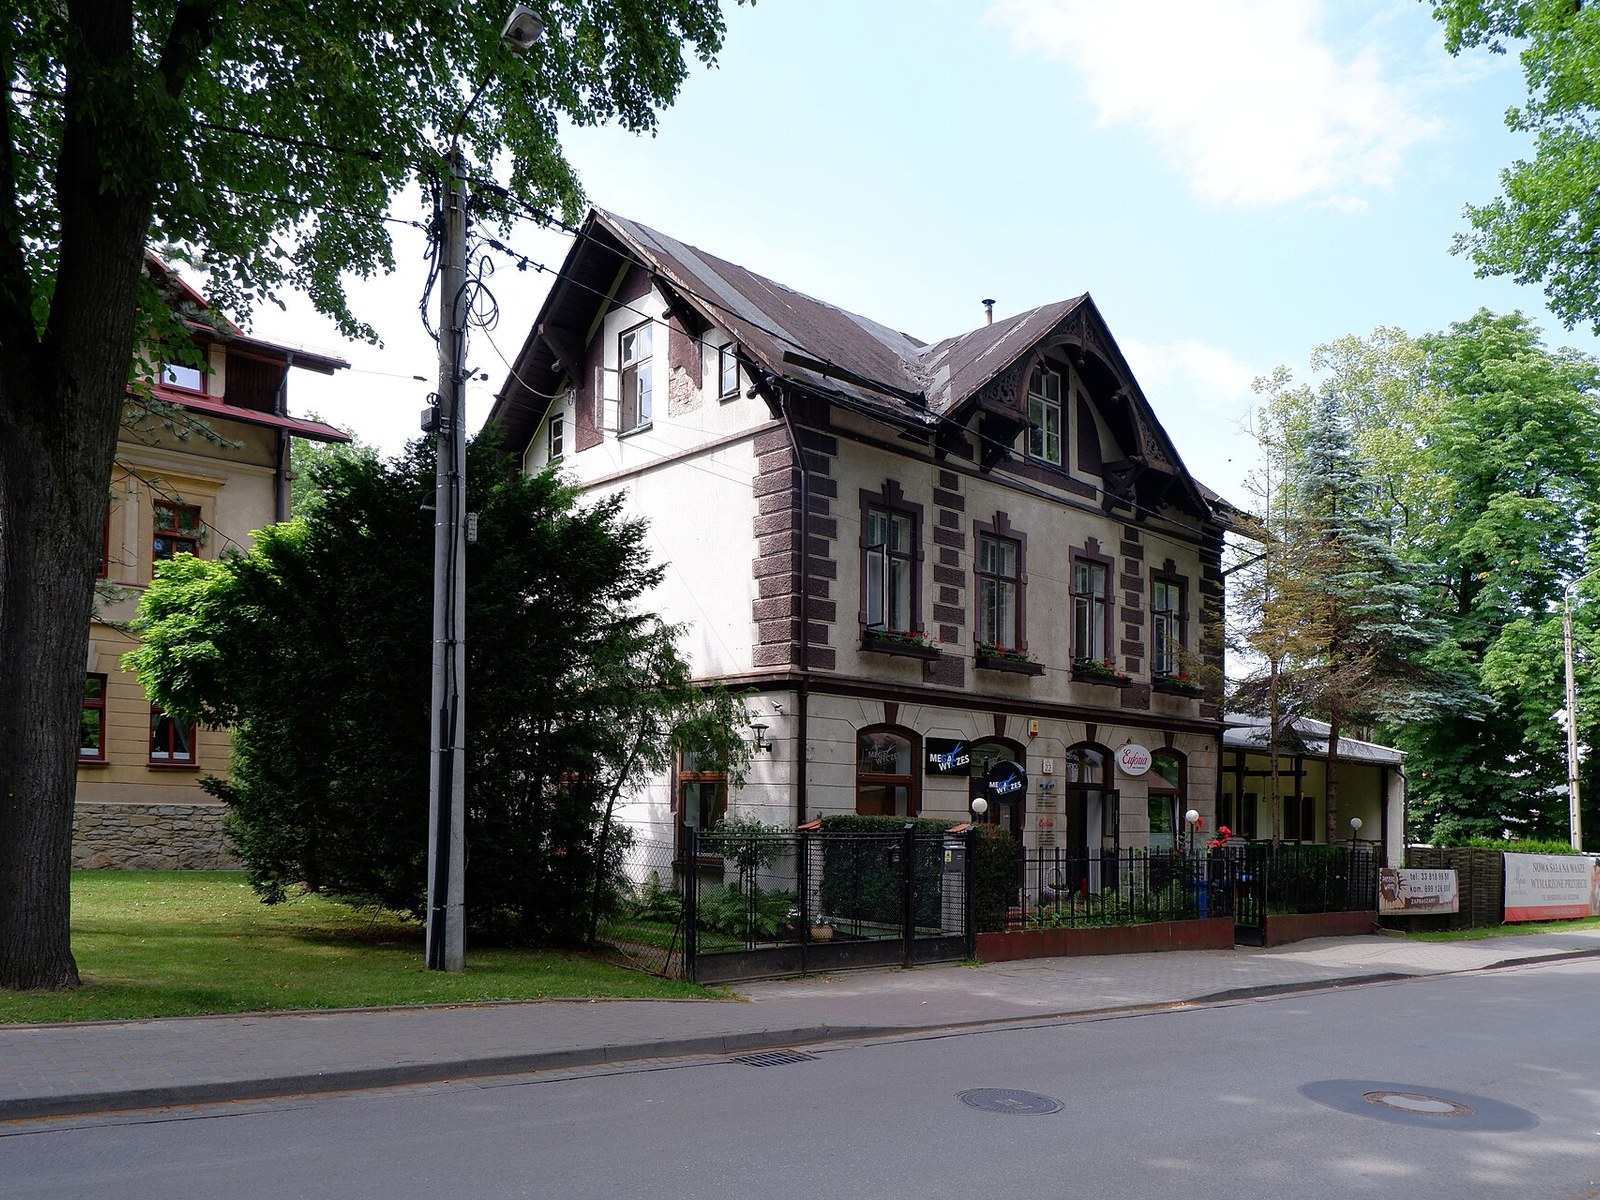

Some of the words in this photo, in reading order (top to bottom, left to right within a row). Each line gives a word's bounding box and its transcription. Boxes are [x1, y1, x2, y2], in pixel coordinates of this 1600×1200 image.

[929, 753, 952, 763] MEGA
[938, 754, 970, 771] WYCZES
[1044, 763, 1052, 772] 22
[988, 780, 1007, 790] MEGA
[995, 780, 1022, 795] WYCZES
[1421, 872, 1428, 880] 33
[1410, 884, 1423, 893] kom.
